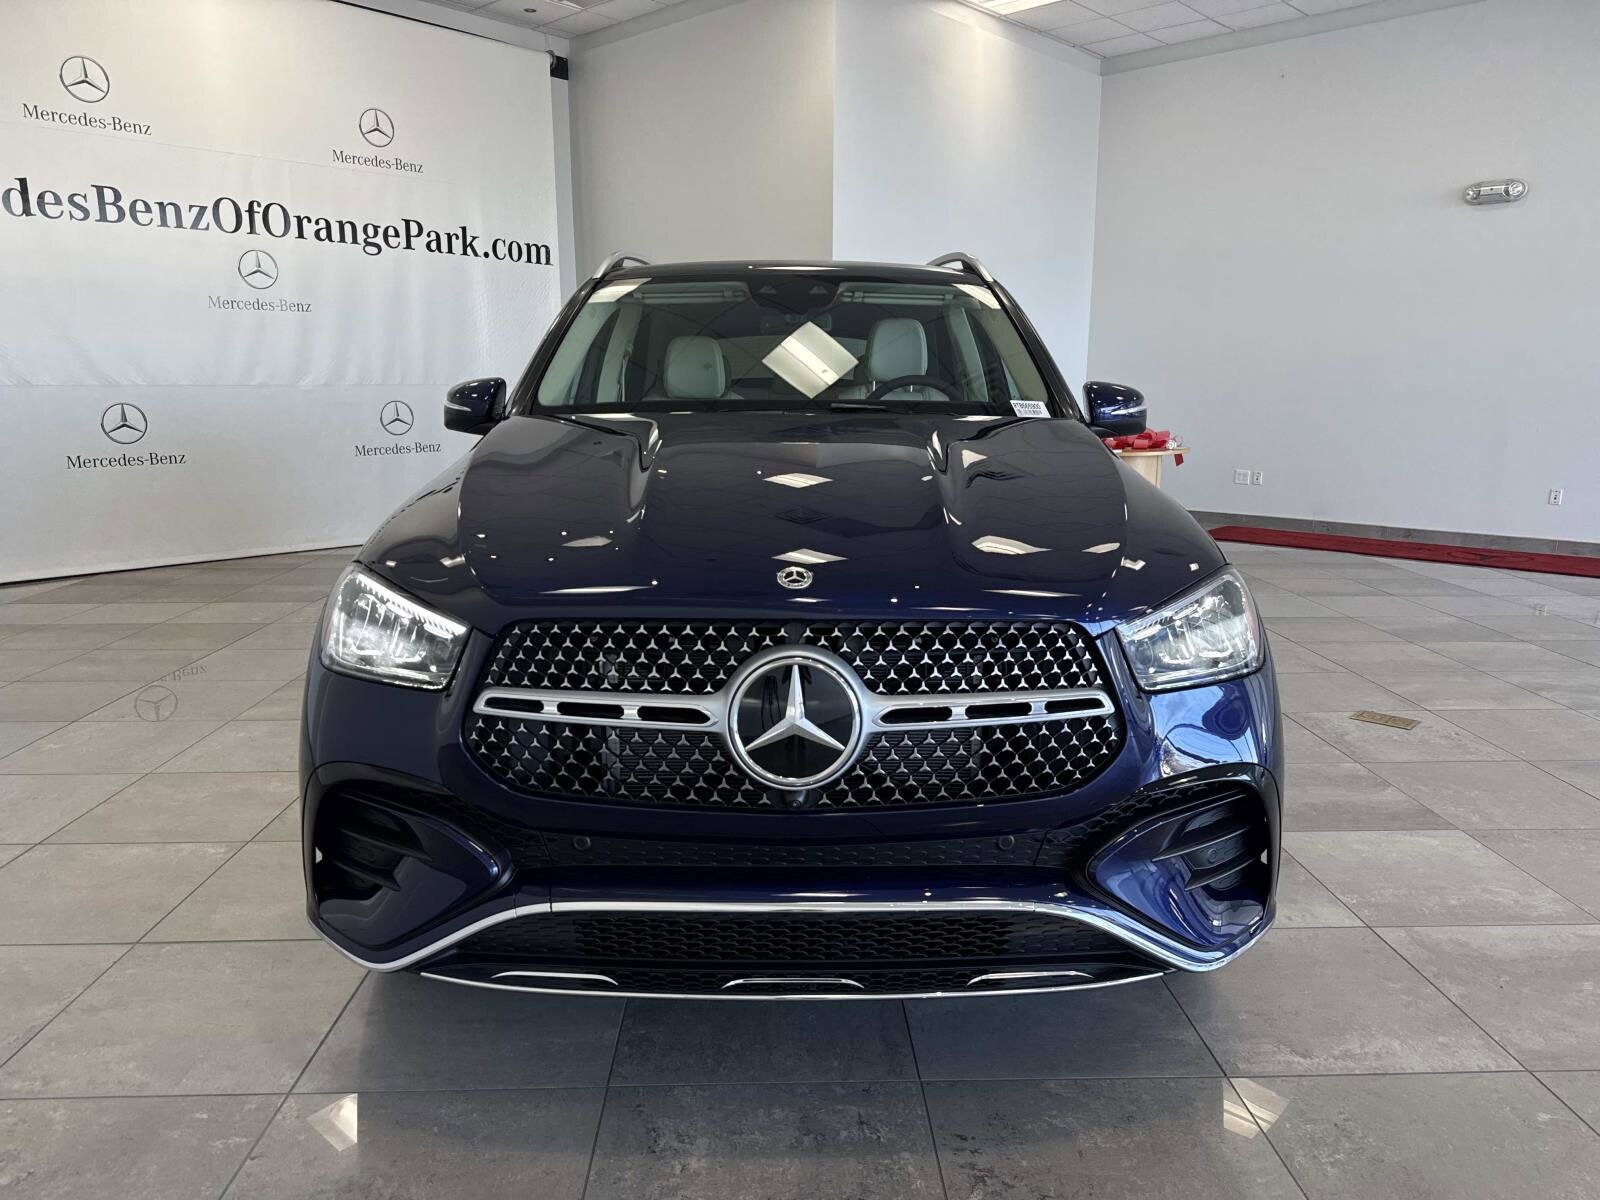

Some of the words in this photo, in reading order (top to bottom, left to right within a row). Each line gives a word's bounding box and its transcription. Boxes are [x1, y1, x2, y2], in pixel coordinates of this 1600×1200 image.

[22, 103, 152, 136] Mercedes-Benz
[332, 149, 424, 174] Mercedes-Benz
[2, 177, 553, 266] desBenzOfOrangePark.com
[207, 295, 312, 314] Mercedes-Benz
[354, 441, 442, 457] Mercedes-Benz
[66, 452, 187, 470] Mercedes-Benz
